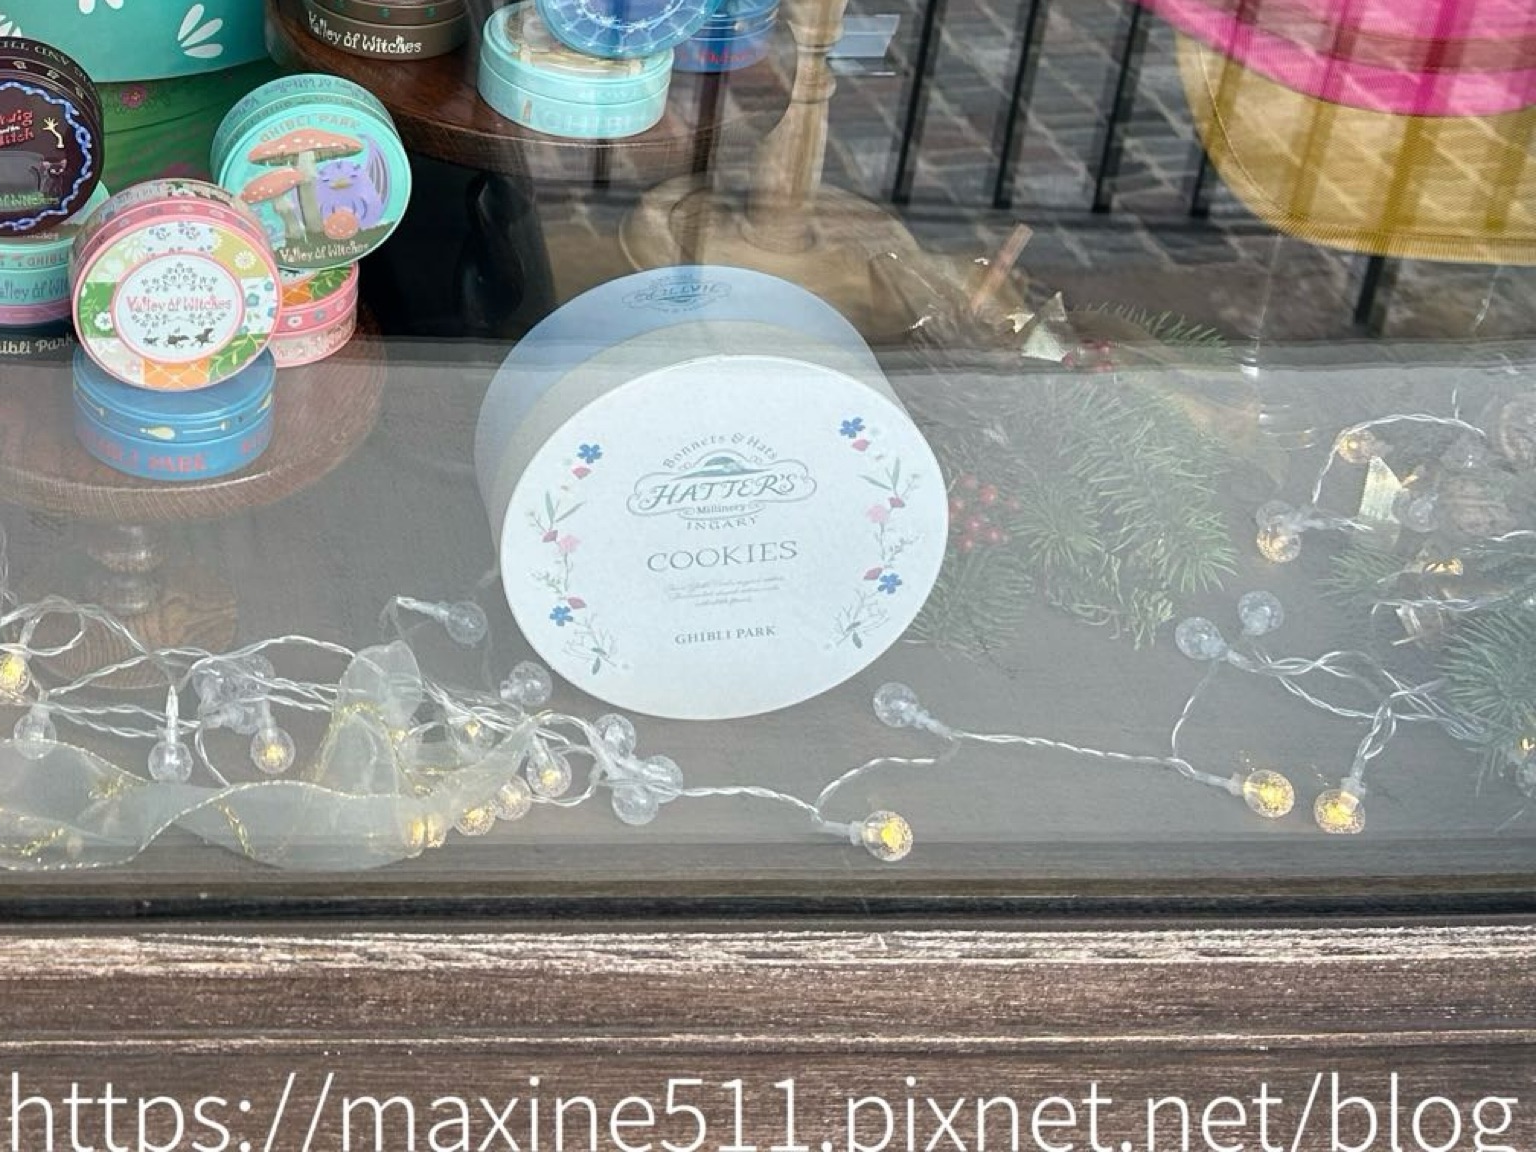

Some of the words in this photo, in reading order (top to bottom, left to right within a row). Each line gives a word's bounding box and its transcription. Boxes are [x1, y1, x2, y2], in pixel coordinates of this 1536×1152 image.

[307, 9, 342, 46] Valley
[343, 31, 361, 51] of
[361, 34, 423, 55] Witches
[317, 113, 363, 130] PARK
[278, 246, 314, 263] Valley
[314, 244, 326, 259] of
[326, 240, 370, 258] Witches
[31, 277, 48, 298] of
[124, 294, 164, 314] Valley
[167, 295, 183, 312] of
[183, 294, 233, 311] Witches
[35, 333, 74, 353] Park
[662, 435, 726, 469] Bonnets
[730, 432, 745, 444] &
[746, 435, 778, 460] Hats
[638, 473, 798, 511] HATTER'S
[695, 504, 747, 516] Millinery
[686, 515, 758, 531] INGARY
[647, 540, 799, 573] COOKIES
[674, 629, 732, 645] GHIBLI
[736, 625, 777, 640] PARK
